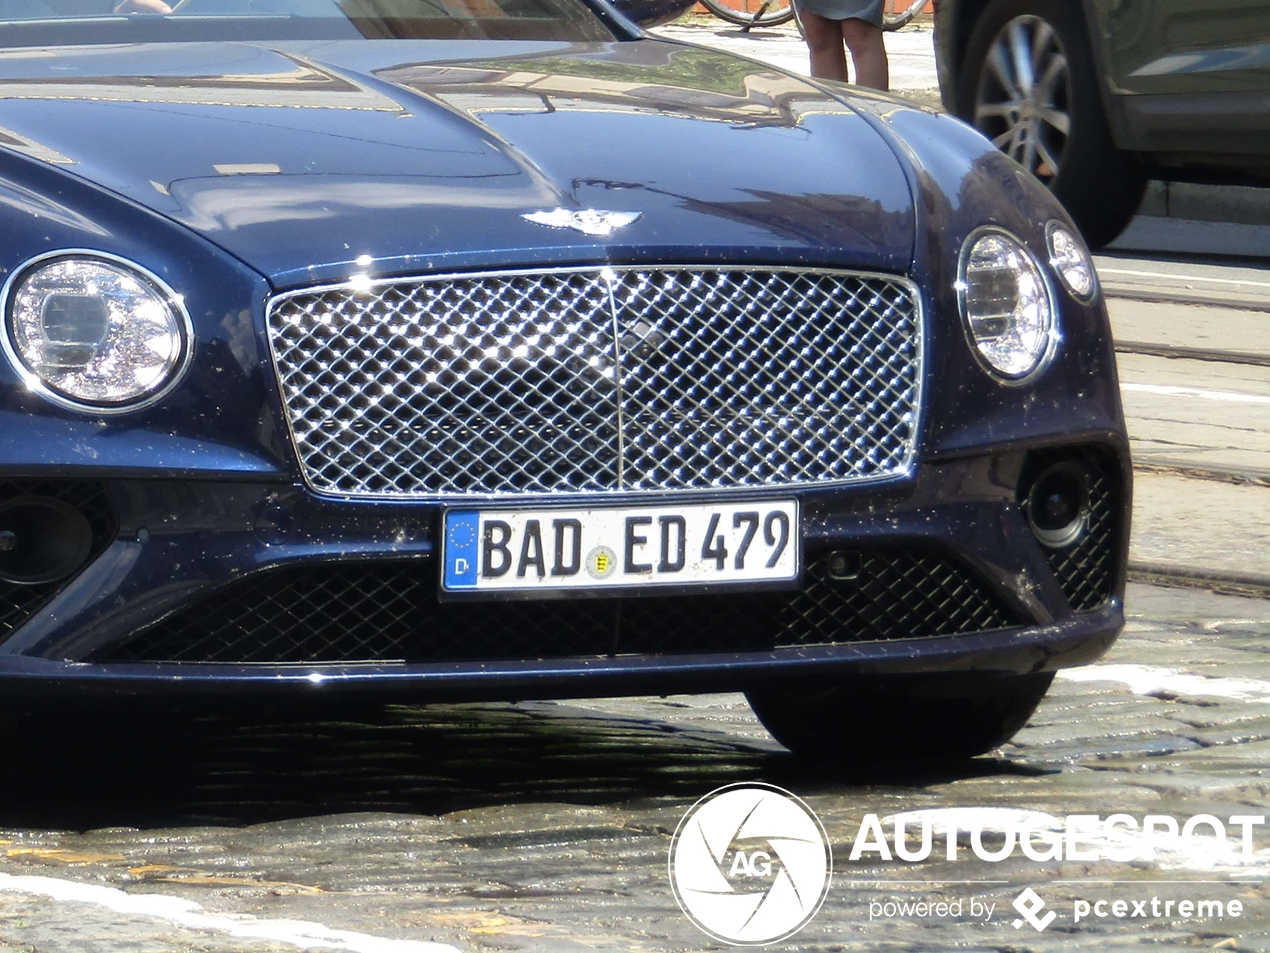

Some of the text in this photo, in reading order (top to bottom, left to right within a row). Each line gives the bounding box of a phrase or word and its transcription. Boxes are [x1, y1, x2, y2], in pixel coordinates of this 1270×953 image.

[455, 558, 468, 575] D
[481, 518, 583, 578] BAD
[623, 513, 686, 575] ED
[701, 509, 791, 571] 479
